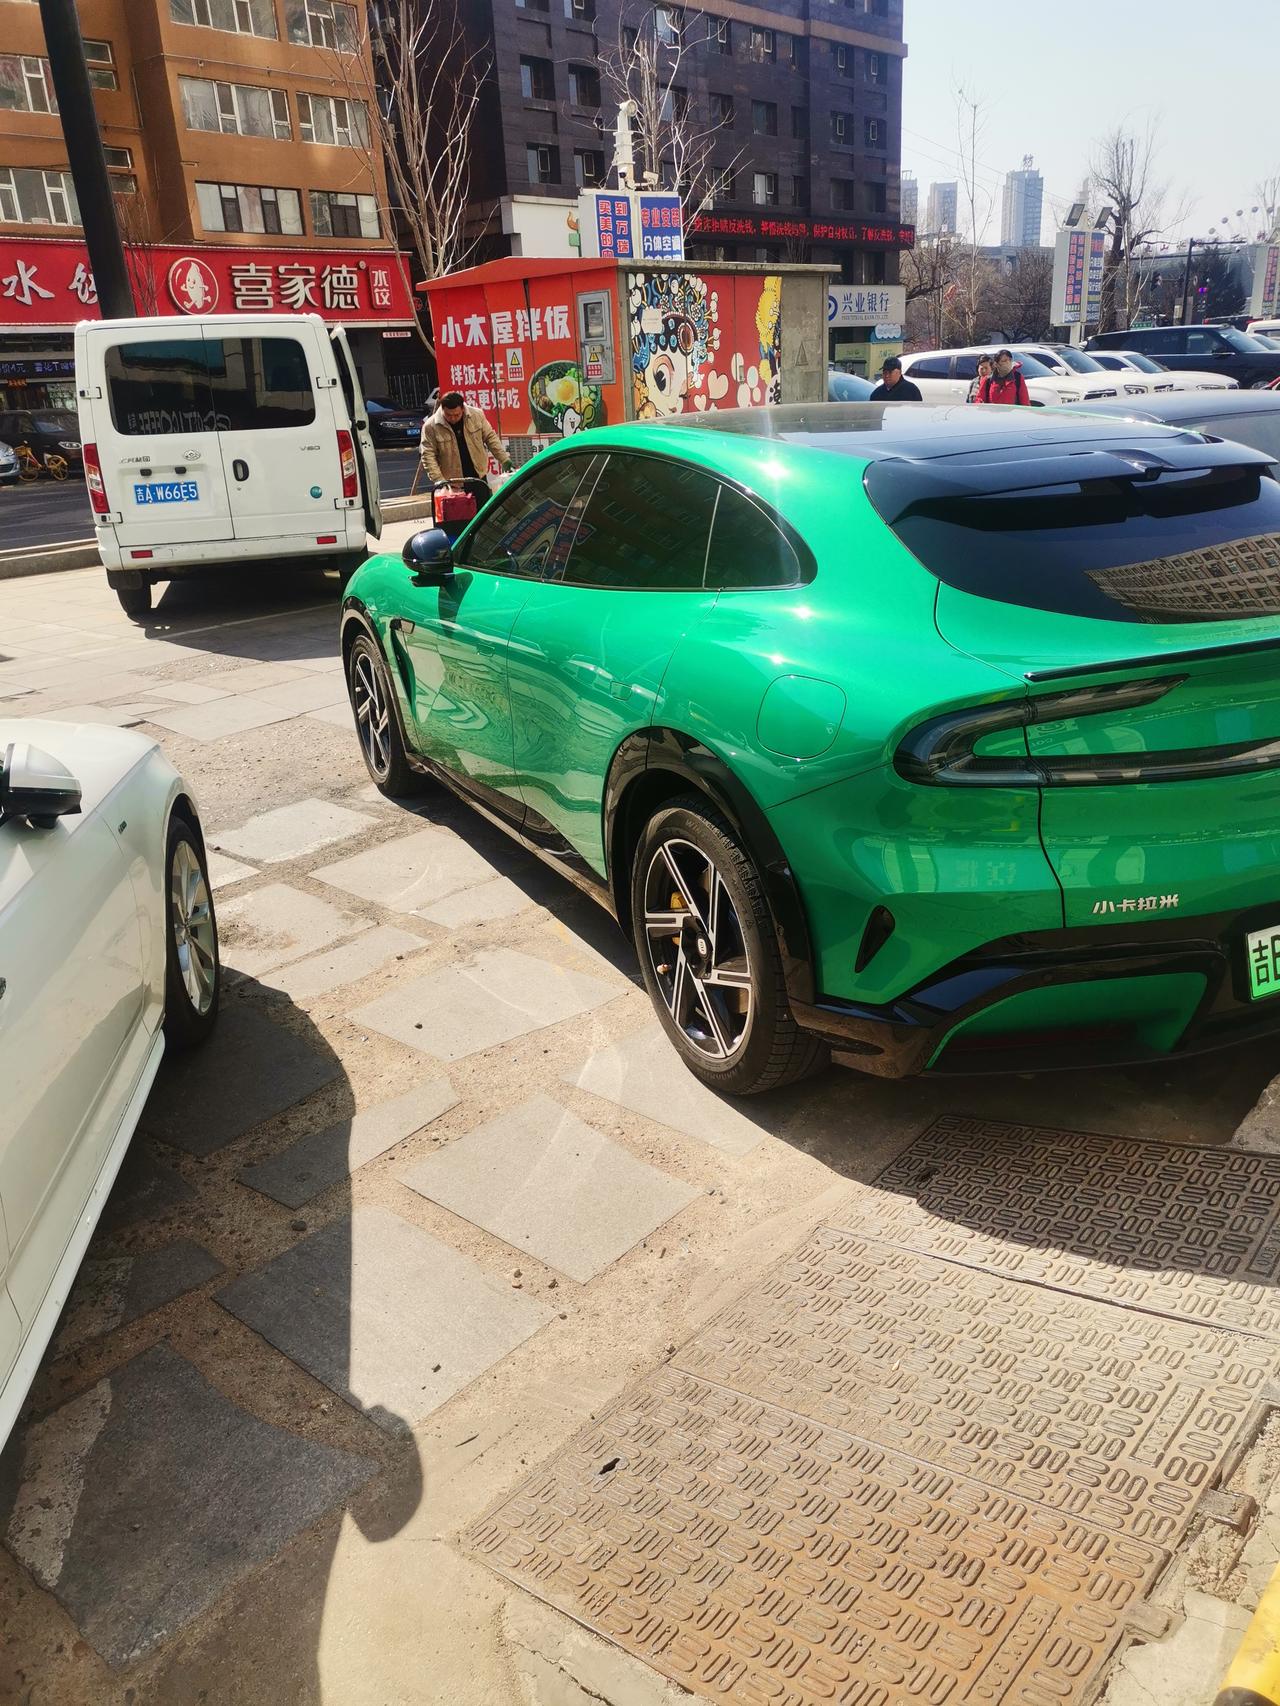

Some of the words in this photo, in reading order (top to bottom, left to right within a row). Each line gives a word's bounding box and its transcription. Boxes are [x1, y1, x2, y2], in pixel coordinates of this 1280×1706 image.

[641, 207, 681, 228] 专业安装
[644, 235, 681, 251] 分体空调
[230, 262, 361, 310] 喜家德
[372, 270, 391, 305] 水饺
[842, 292, 889, 312] 兴业银行
[441, 305, 571, 348] 小木屋拌饭
[450, 363, 505, 386] 拌饭大王
[1092, 894, 1179, 914] 小卡拉米
